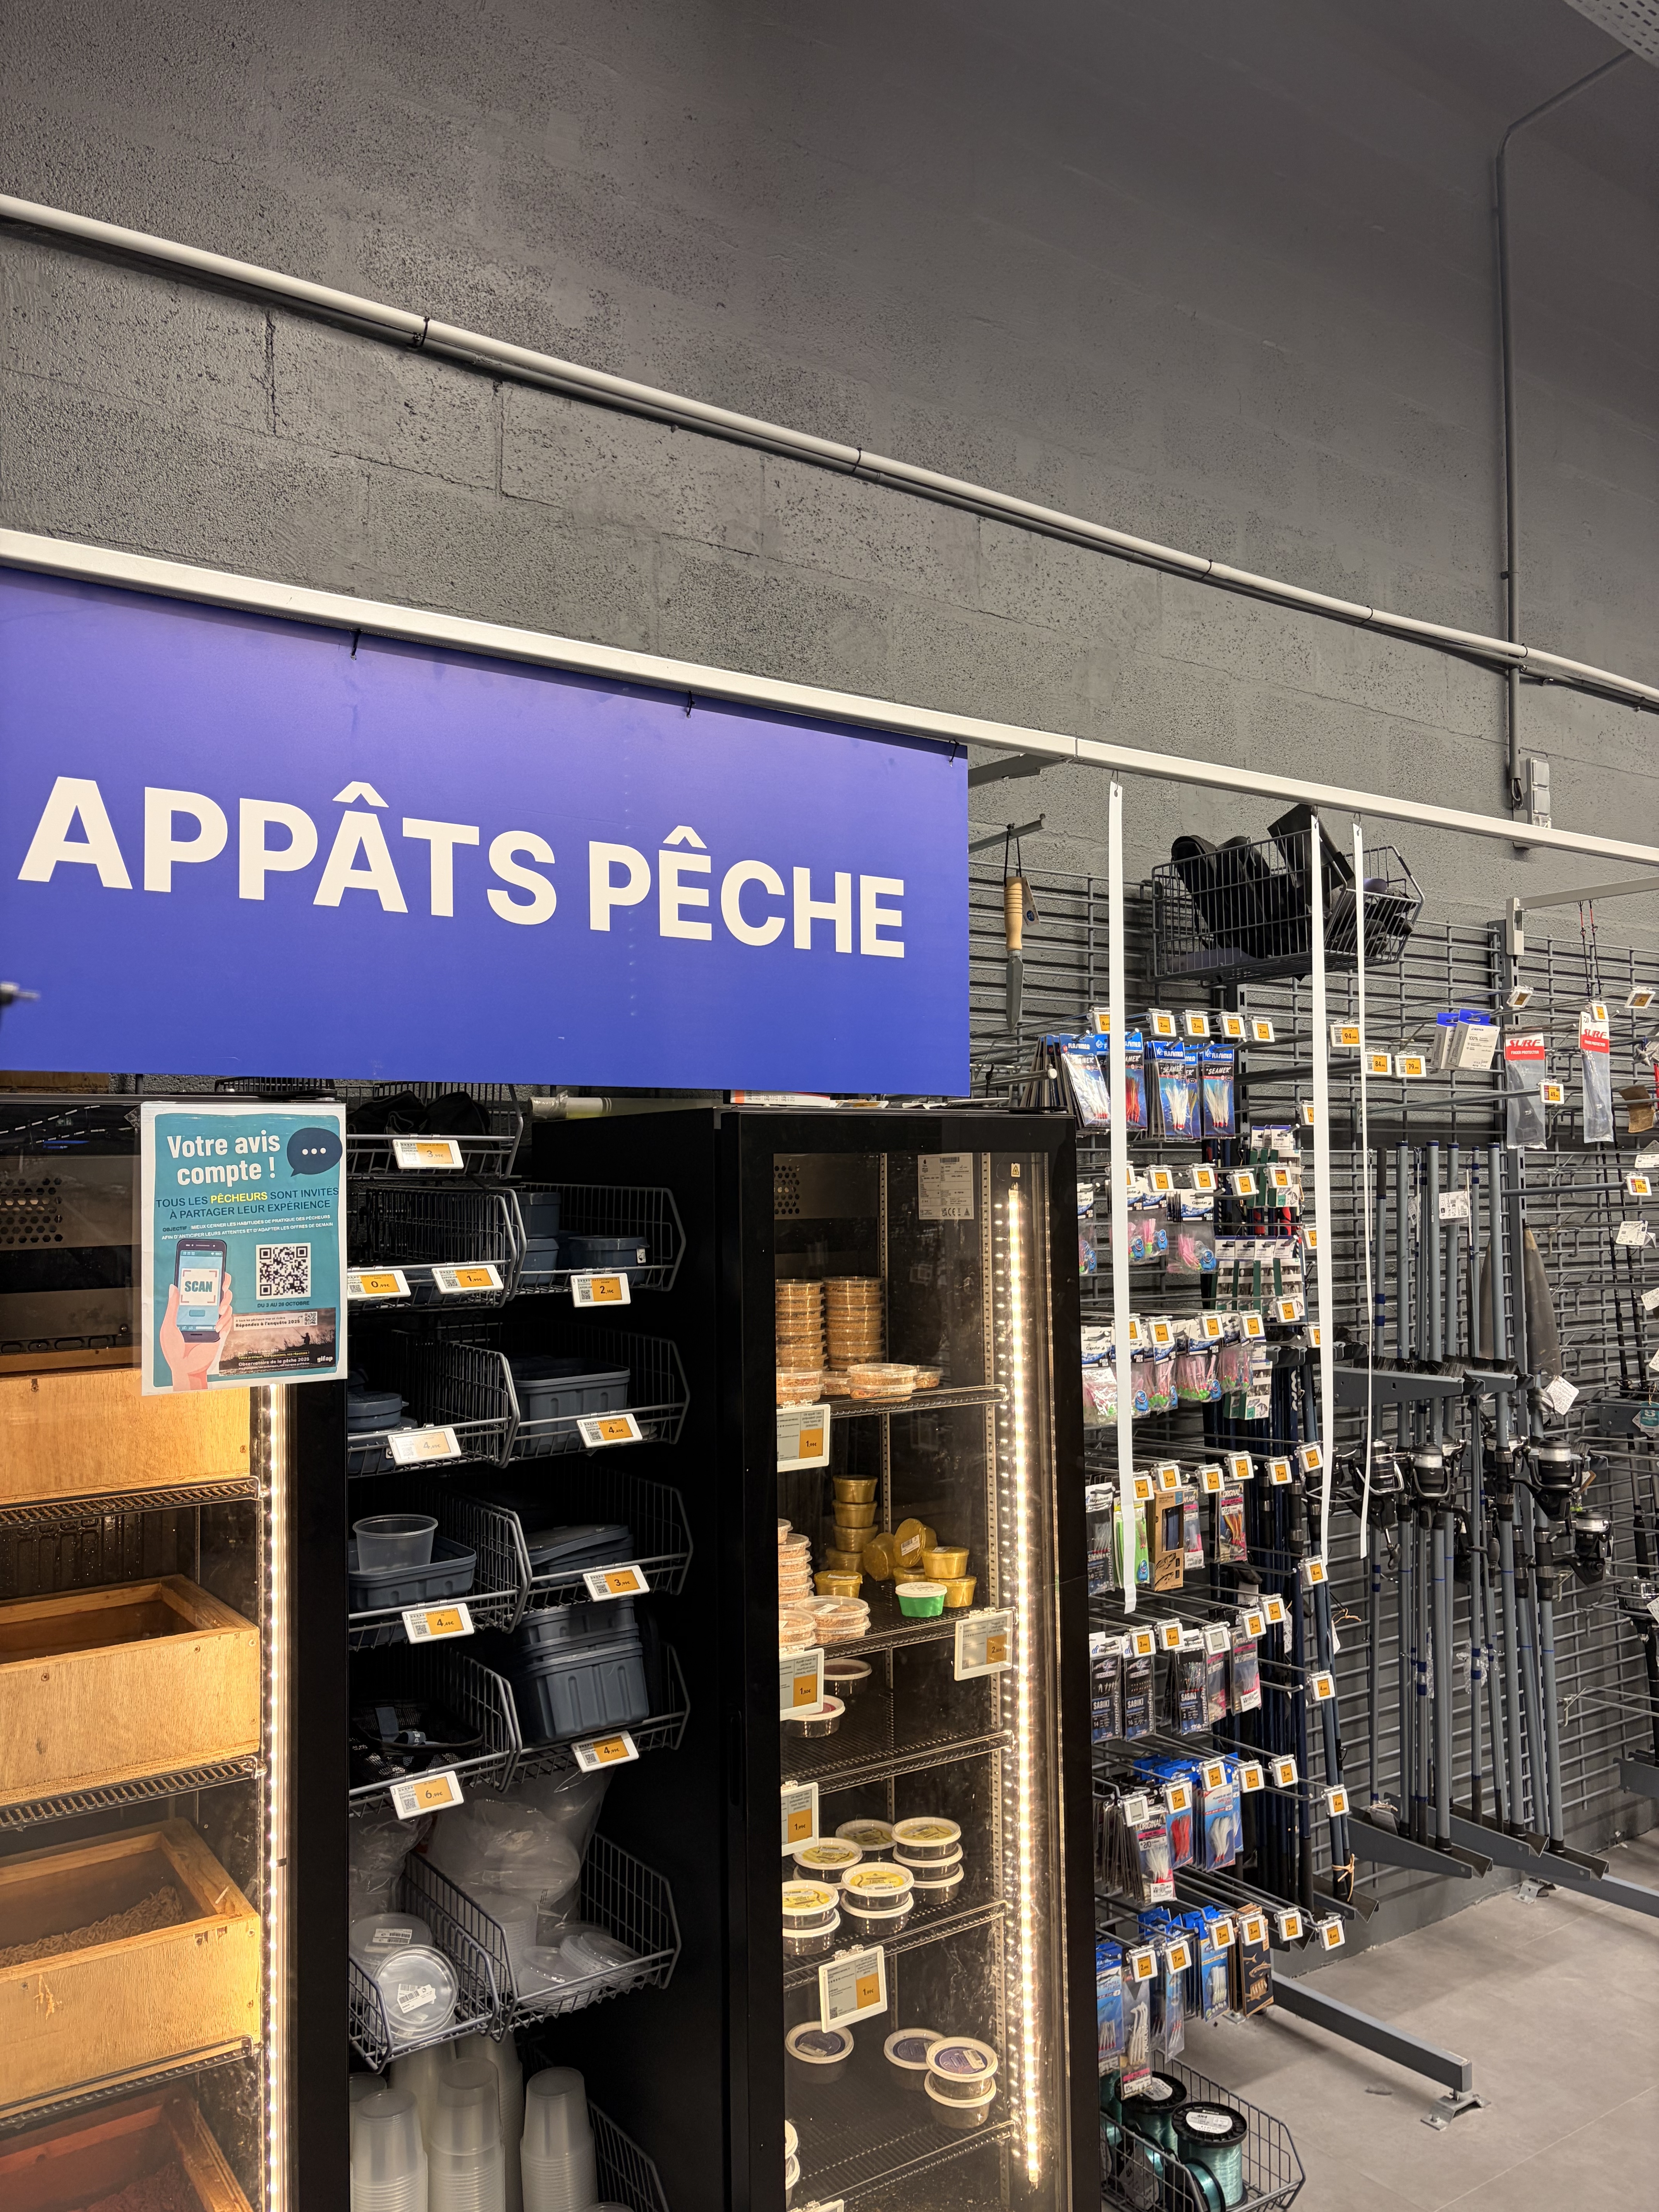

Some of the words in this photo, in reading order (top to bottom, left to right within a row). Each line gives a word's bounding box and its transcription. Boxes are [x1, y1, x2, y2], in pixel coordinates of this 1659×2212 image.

[17, 776, 557, 925] APPÂTS
[589, 826, 905, 958] PÊCHE
[1584, 1029, 1607, 1039] SURF
[167, 1135, 228, 1158] Votre
[235, 1130, 280, 1154] avis
[177, 1160, 261, 1187] compte
[269, 1156, 275, 1178] !
[157, 1198, 185, 1207] TOUS
[189, 1196, 208, 1206] LES
[211, 1192, 268, 1204] PÊCHEURS
[270, 1190, 298, 1200] SONT
[301, 1186, 339, 1197] INVITÉS
[170, 1209, 177, 1219] À
[180, 1207, 235, 1218] PARTAGER
[238, 1205, 265, 1214] LEUR
[268, 1200, 331, 1212] EXPÉRIENCE
[185, 1281, 212, 1292] SCAN
[1181, 1692, 1197, 1702] SABIKI
[1093, 1699, 1110, 1710] SABIKI
[1127, 1698, 1144, 1709] SABIKI
[425, 1790, 443, 1799] 6,99€
